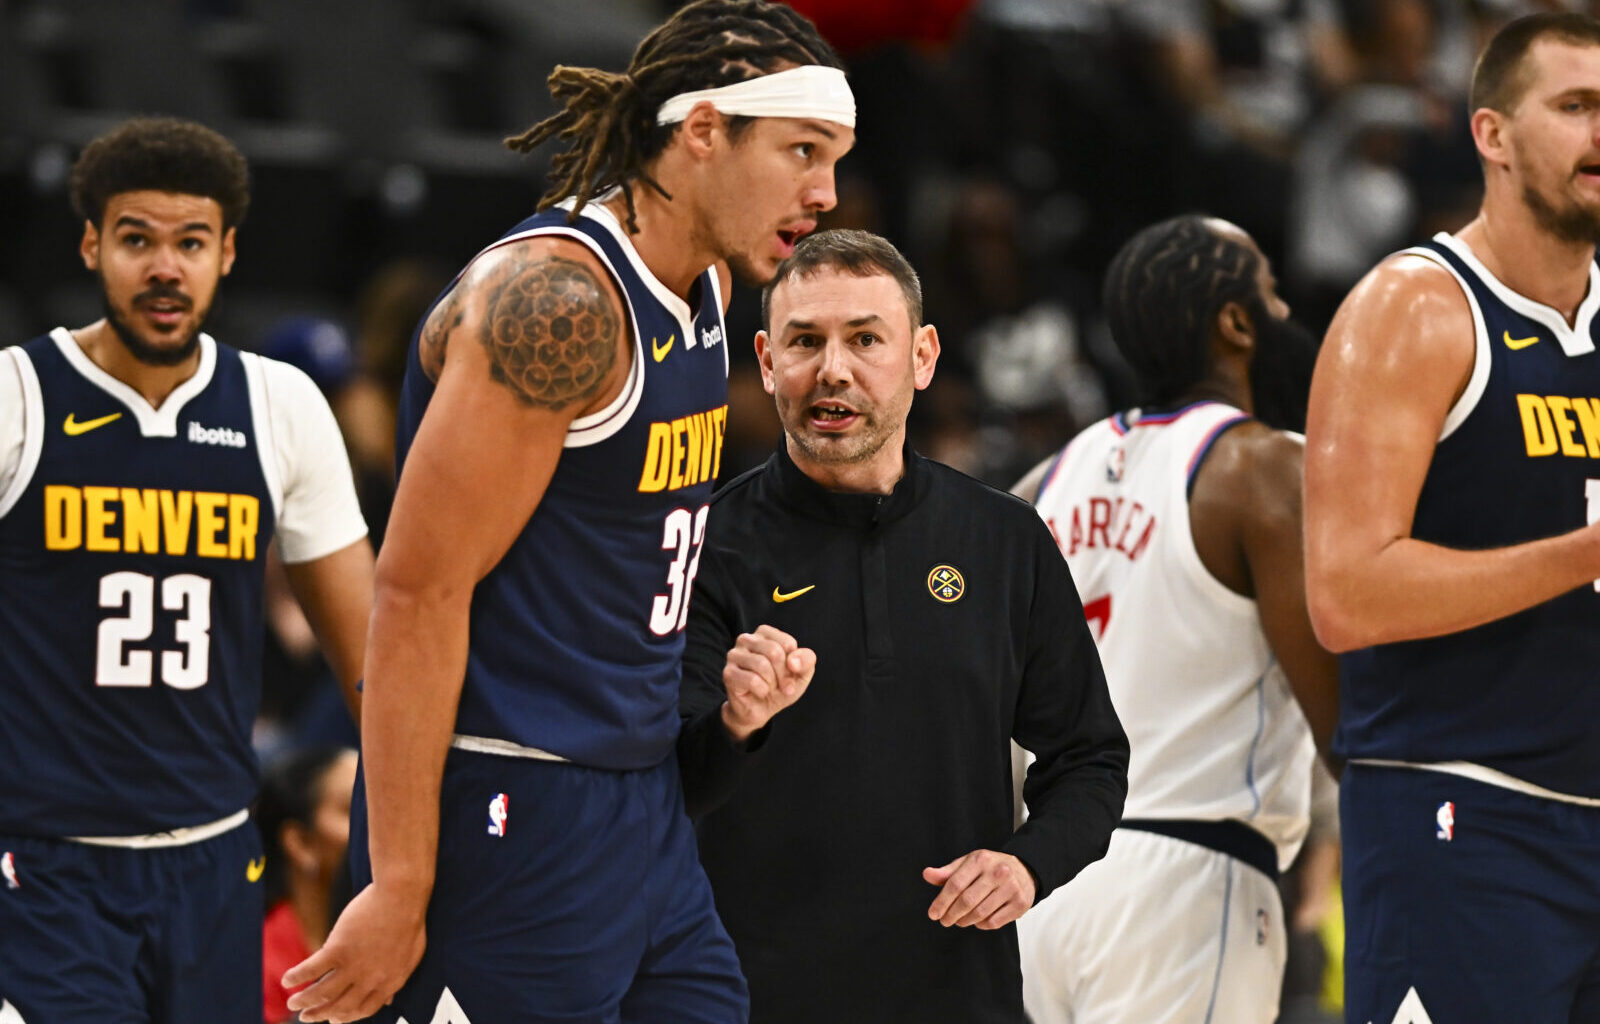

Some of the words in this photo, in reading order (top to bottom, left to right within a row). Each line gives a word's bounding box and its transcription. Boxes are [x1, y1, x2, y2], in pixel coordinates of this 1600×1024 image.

[188, 421, 247, 448] ibotta
[638, 404, 728, 493] DENVE
[44, 485, 259, 561] DENVER
[96, 571, 211, 690] 23
